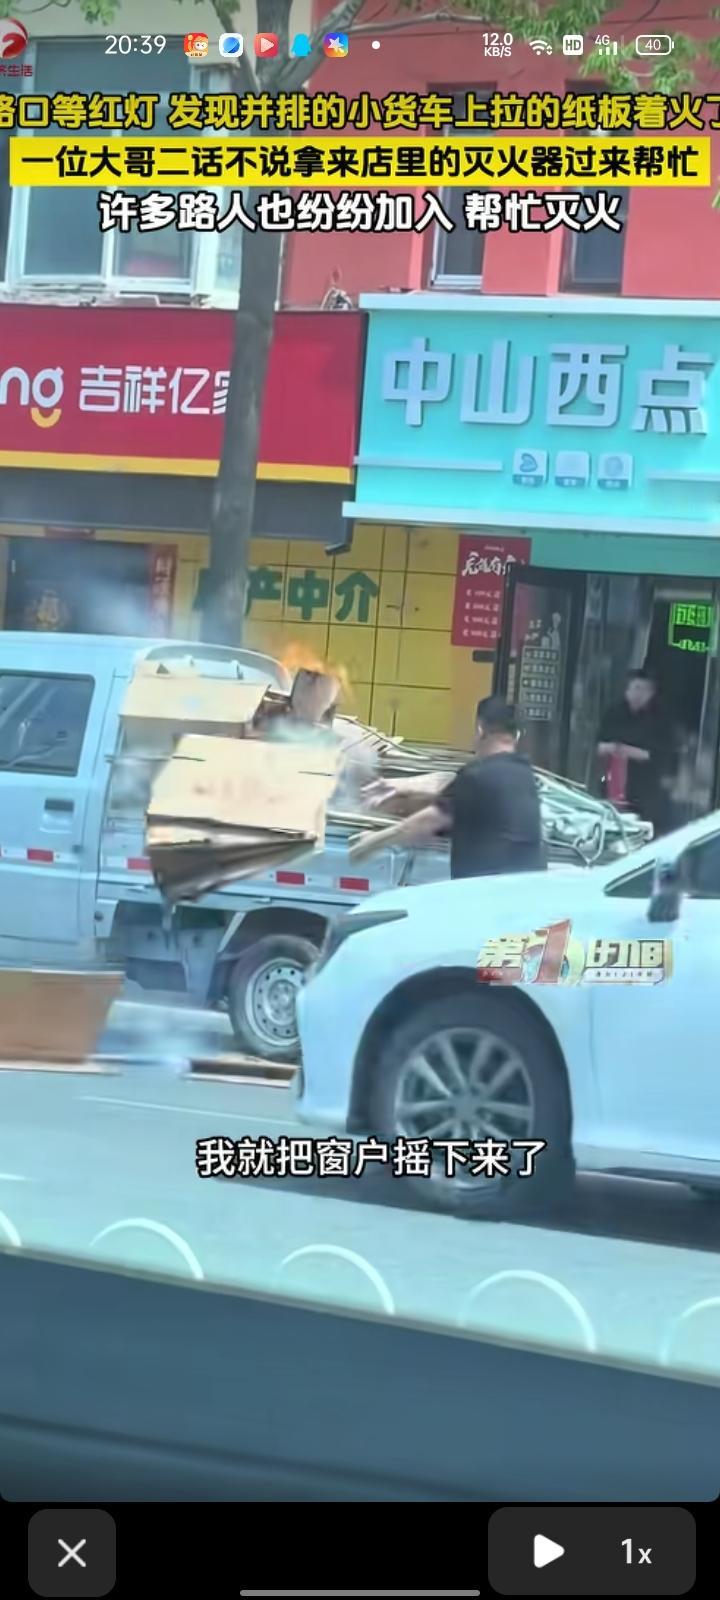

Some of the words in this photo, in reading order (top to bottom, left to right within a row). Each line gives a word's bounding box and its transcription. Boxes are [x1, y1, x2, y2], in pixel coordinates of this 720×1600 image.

[380, 337, 716, 436] 中山西点
[193, 568, 379, 623] 产中介
